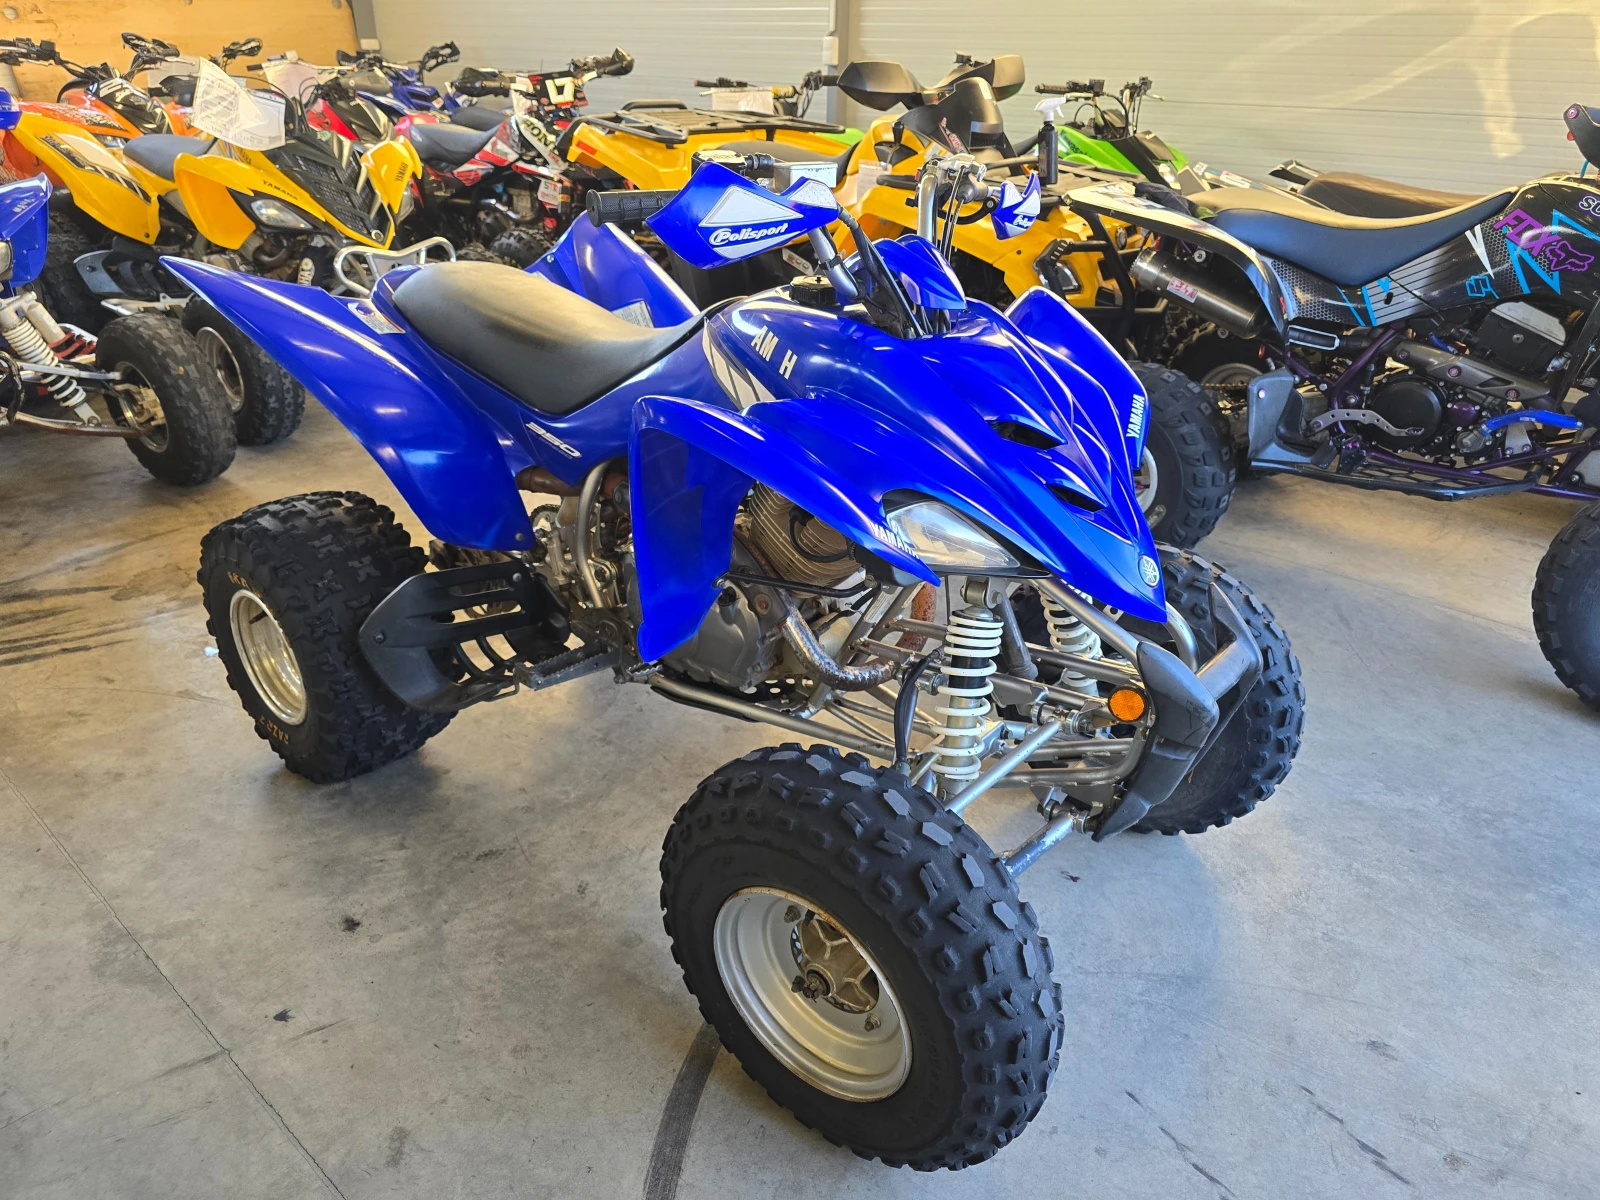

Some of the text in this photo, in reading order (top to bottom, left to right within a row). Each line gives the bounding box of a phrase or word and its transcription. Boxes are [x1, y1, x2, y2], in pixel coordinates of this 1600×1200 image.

[262, 179, 299, 201] YAMAHA
[708, 222, 789, 246] Polisport
[1125, 393, 1146, 439] YAMAHA
[525, 421, 582, 458] 350
[869, 519, 920, 560] YAMAHA
